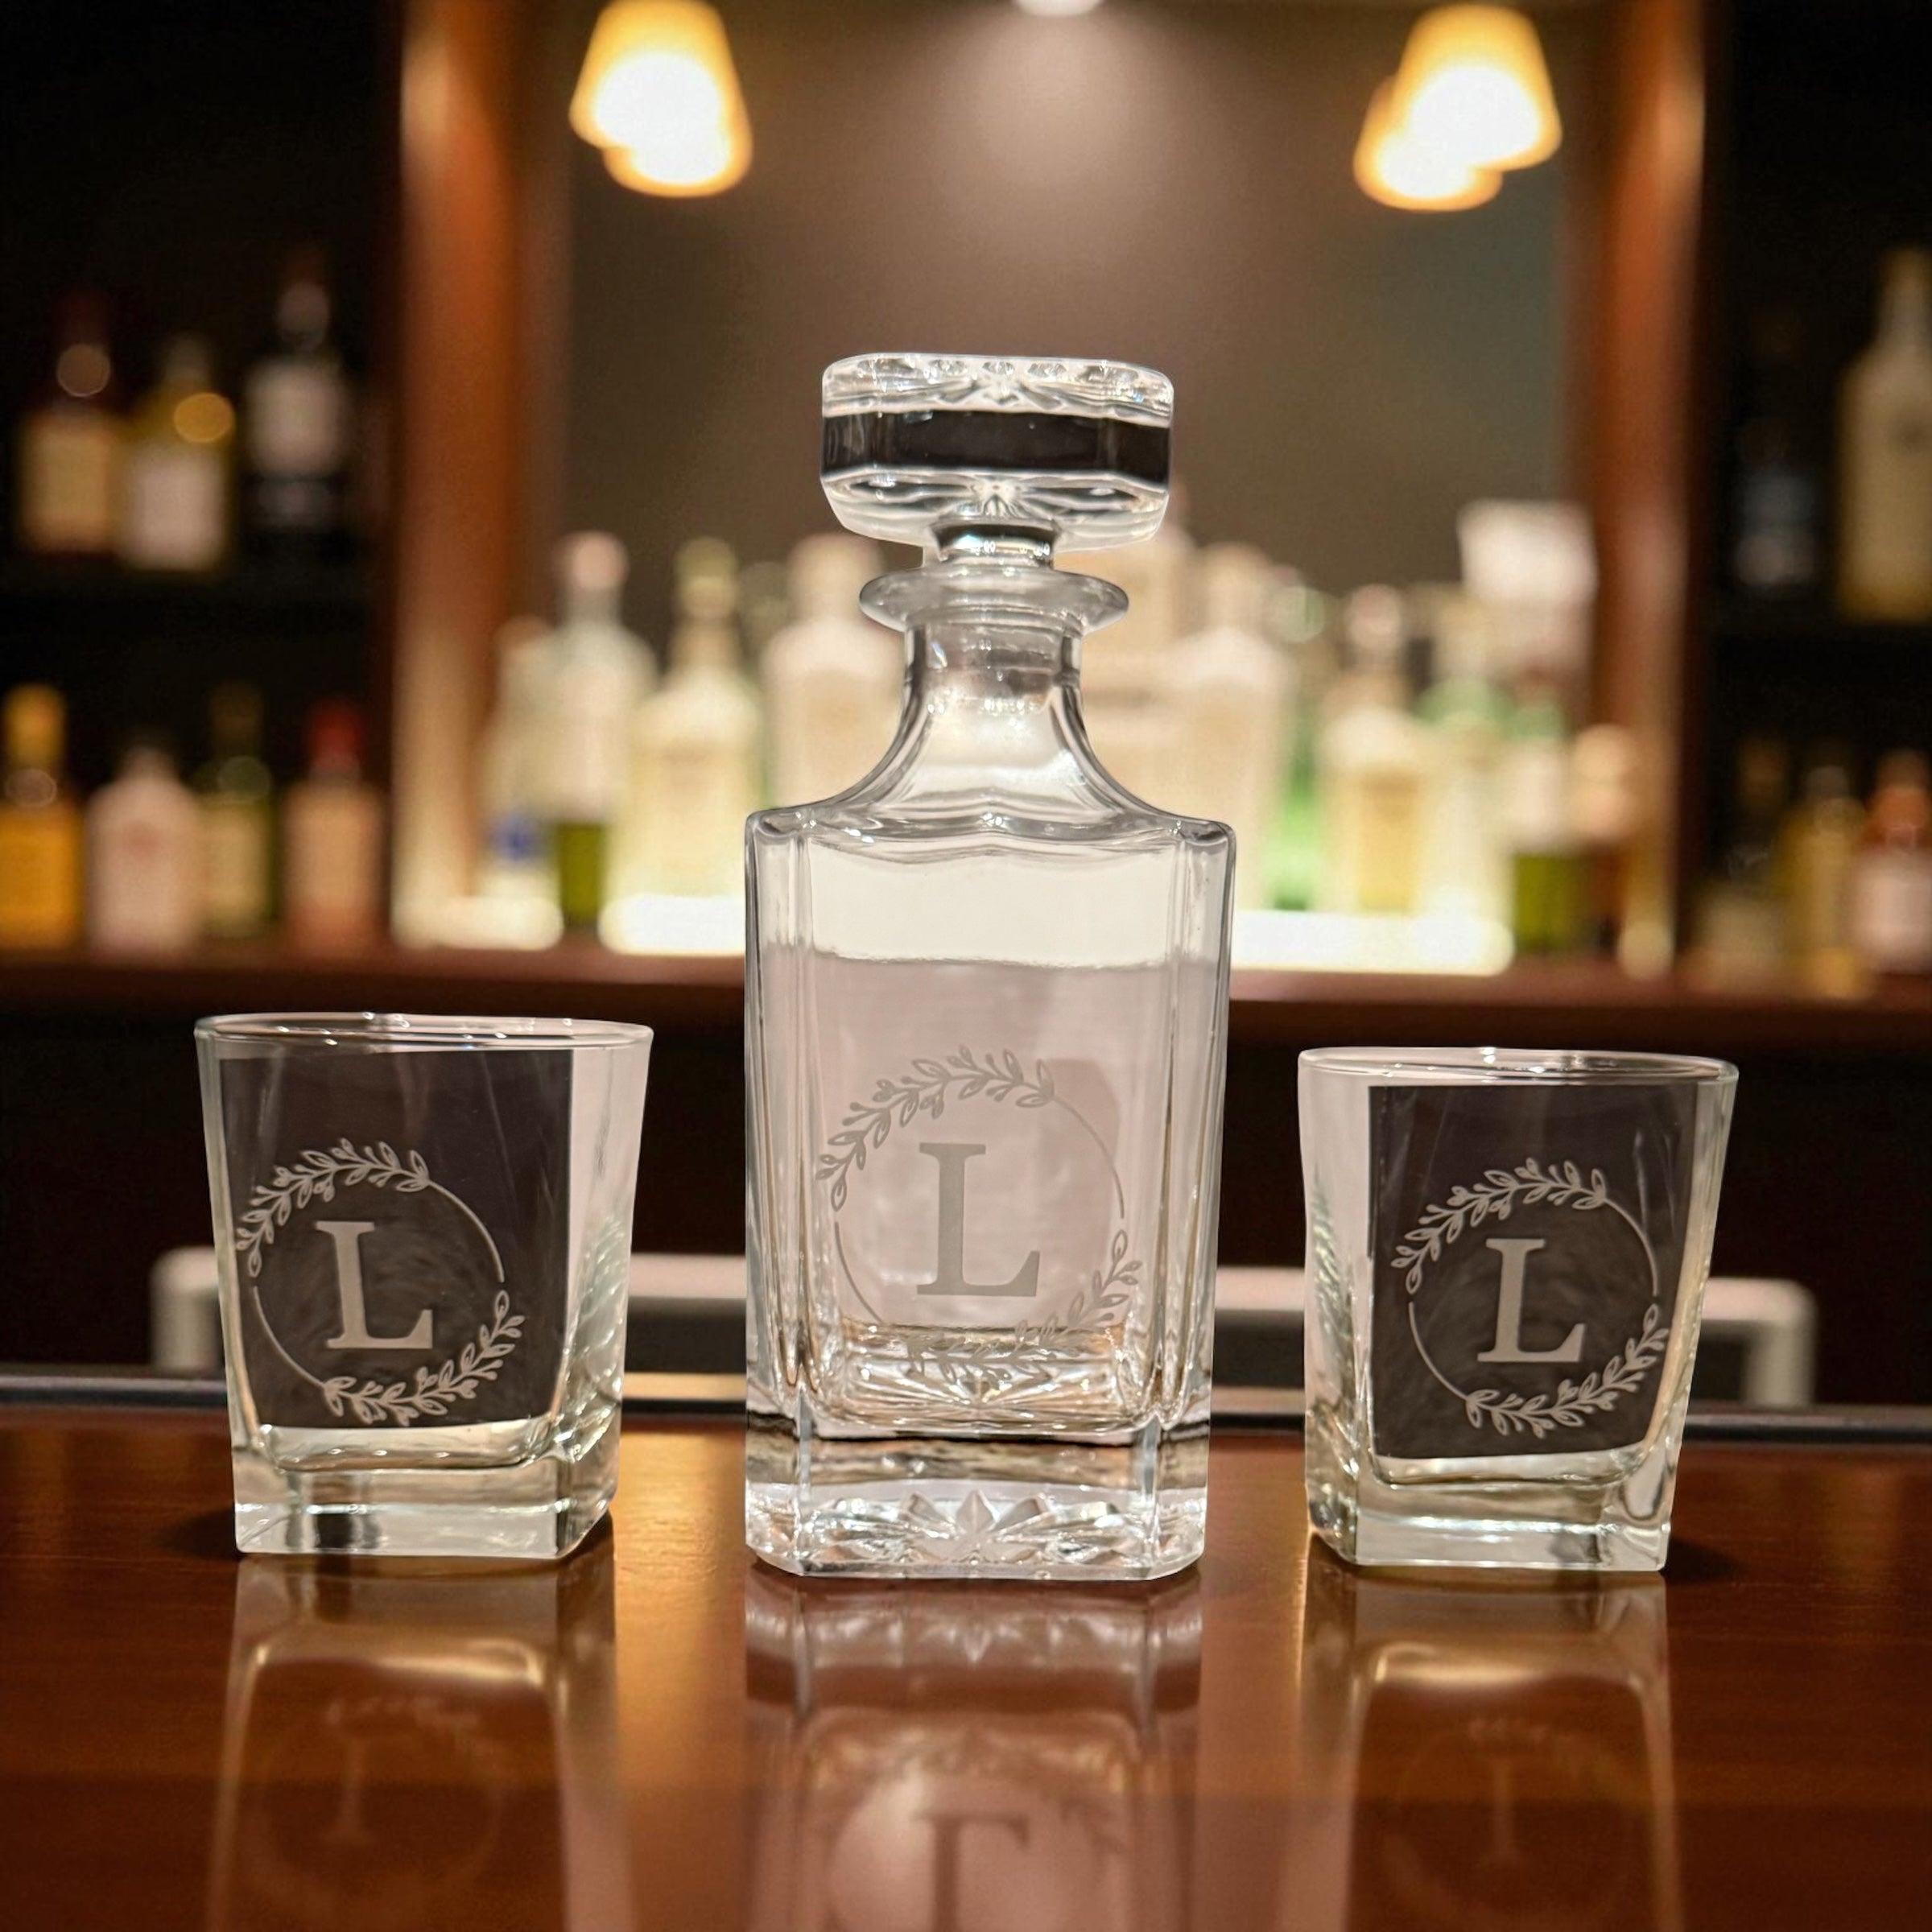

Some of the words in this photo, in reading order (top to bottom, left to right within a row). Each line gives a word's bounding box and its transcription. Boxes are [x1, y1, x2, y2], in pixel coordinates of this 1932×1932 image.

[916, 1141, 1040, 1298] L
[315, 1220, 433, 1349] L
[1477, 1238, 1587, 1363] L
